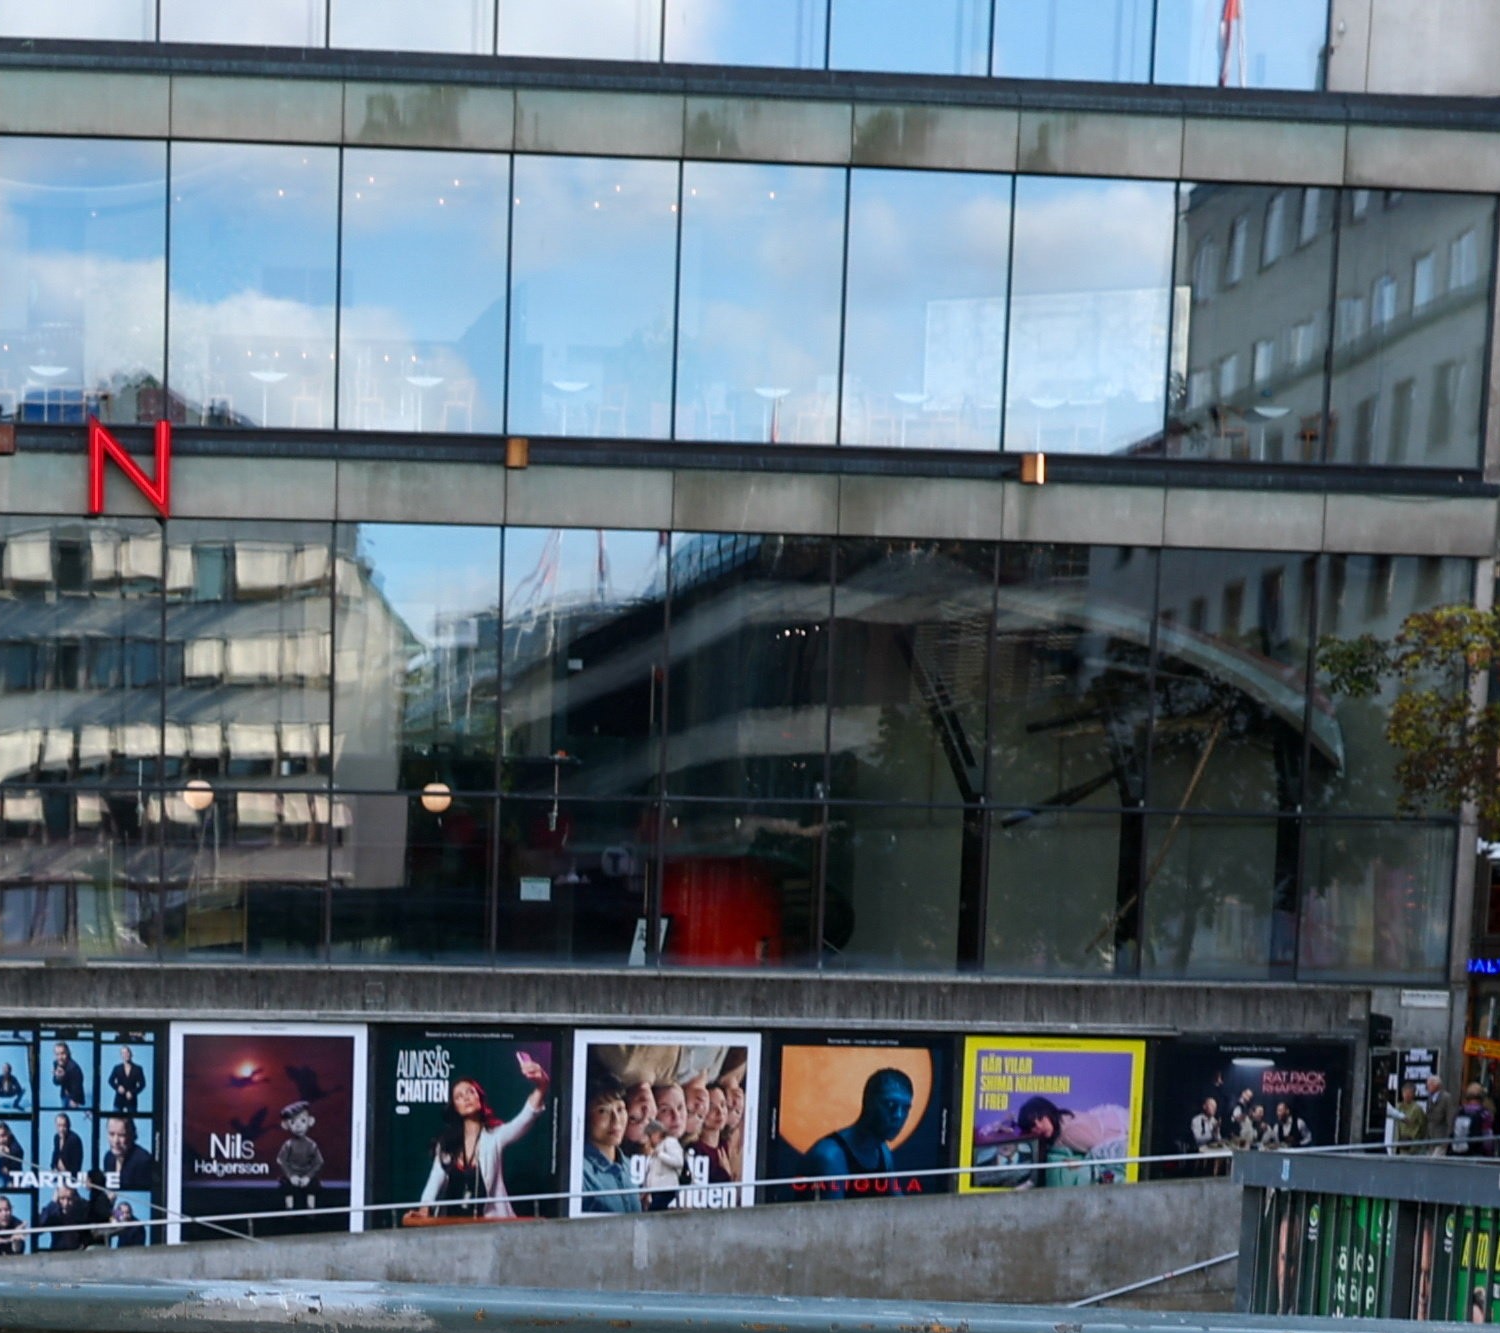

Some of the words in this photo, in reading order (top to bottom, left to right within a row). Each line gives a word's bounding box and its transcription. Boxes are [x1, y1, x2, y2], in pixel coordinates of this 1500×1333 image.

[1262, 1071, 1288, 1083] RAT
[1290, 1071, 1326, 1083] PACK
[396, 1078, 449, 1104] CHATTEN
[1262, 1083, 1326, 1095] RHAPSODY
[985, 1093, 1009, 1111] FRED
[209, 1132, 255, 1161] Nils
[194, 1159, 269, 1177] Holgersson
